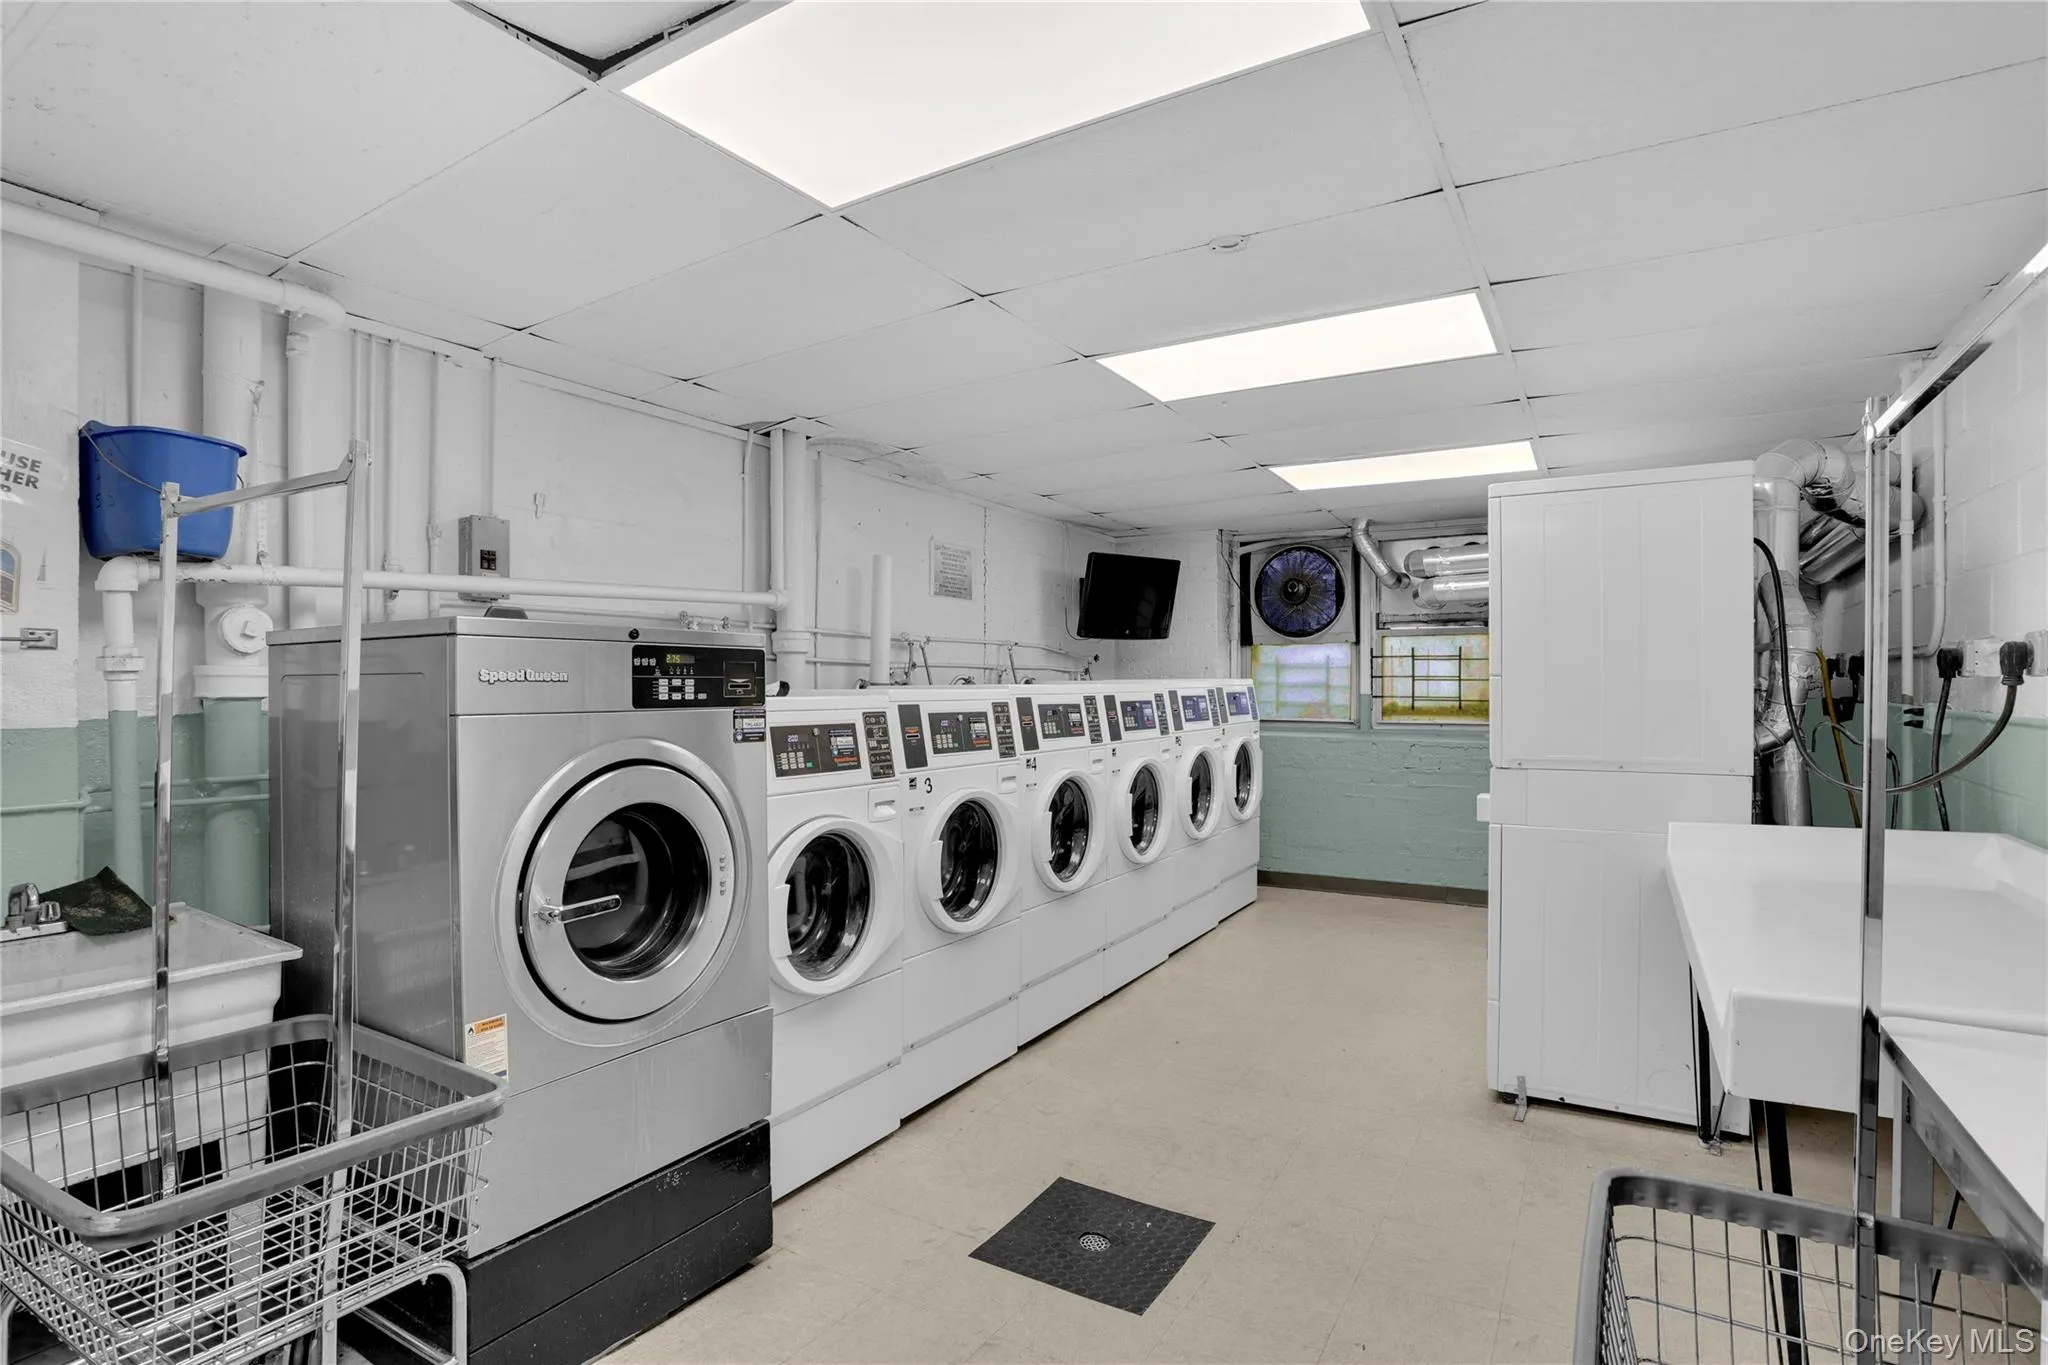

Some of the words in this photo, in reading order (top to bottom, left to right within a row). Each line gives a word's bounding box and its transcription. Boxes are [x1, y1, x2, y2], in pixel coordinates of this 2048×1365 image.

[478, 668, 524, 684] Speed
[525, 669, 568, 682] Queen
[924, 777, 933, 794] 3
